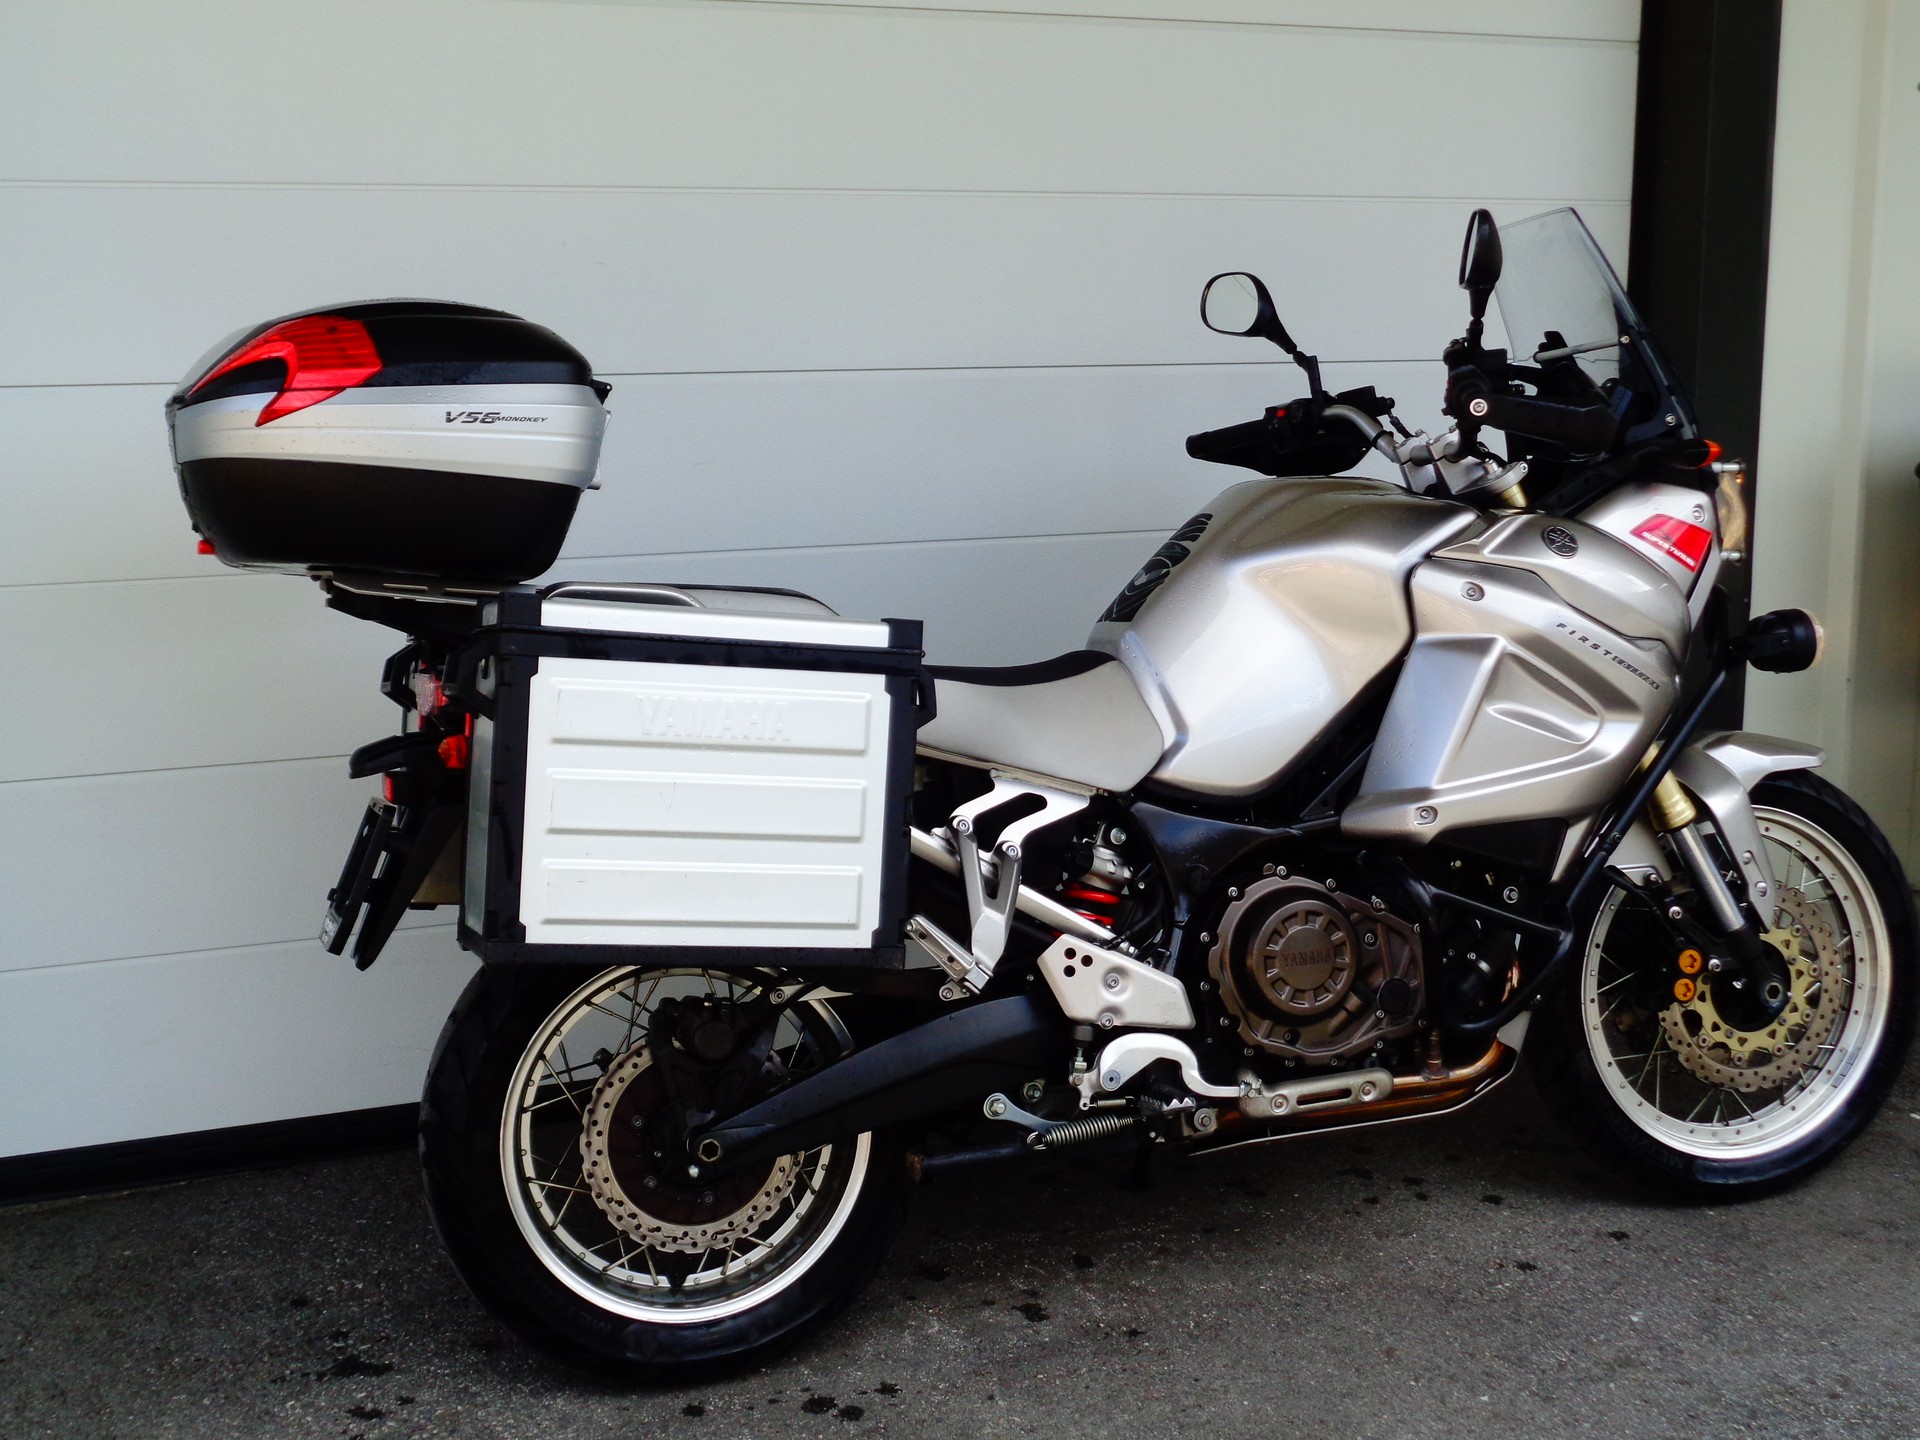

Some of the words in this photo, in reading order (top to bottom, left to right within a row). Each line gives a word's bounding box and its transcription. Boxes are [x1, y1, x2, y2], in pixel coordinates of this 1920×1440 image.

[445, 411, 501, 424] V56
[494, 415, 548, 423] MONOKEY
[1556, 622, 1612, 656] FIRST
[635, 695, 791, 742] YAMAHA
[1281, 948, 1332, 968] YAMAHA
